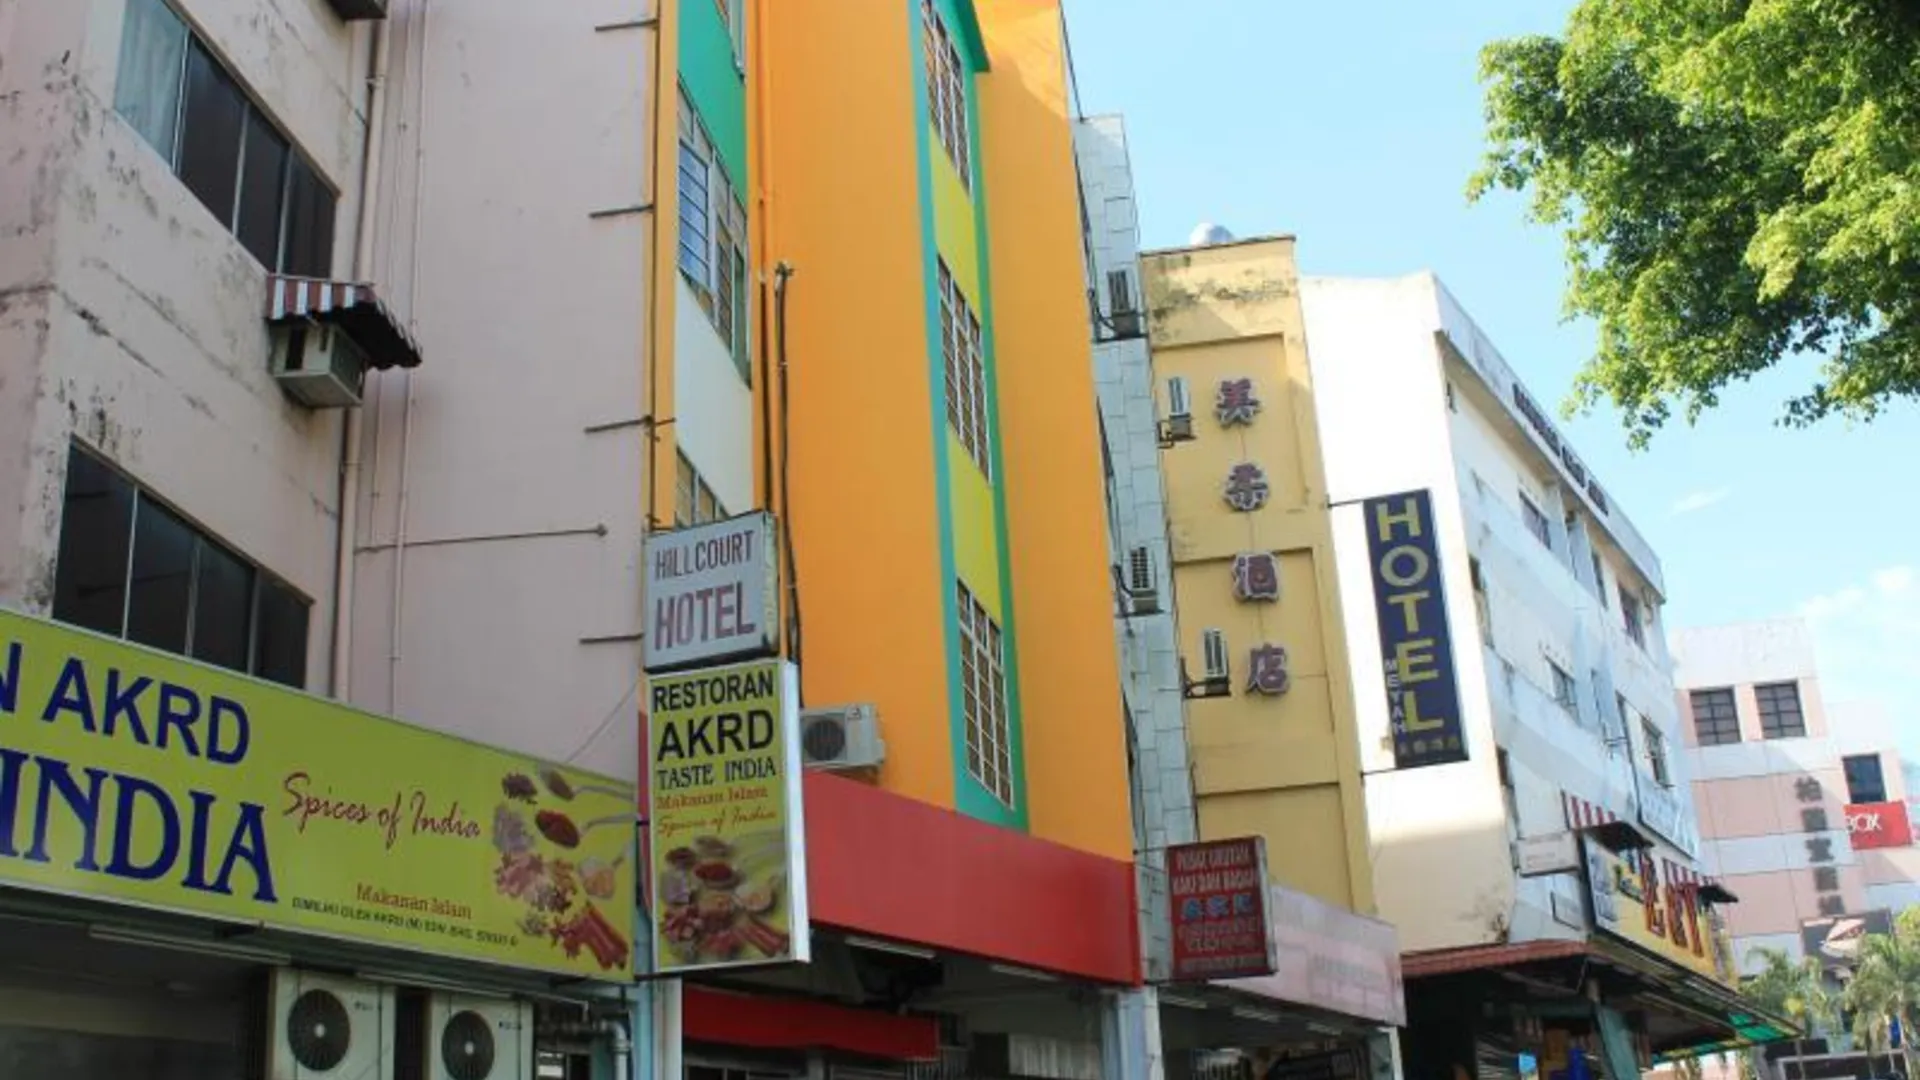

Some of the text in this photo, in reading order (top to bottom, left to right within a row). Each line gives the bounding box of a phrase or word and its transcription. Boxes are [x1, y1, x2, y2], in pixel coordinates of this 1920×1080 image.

[655, 580, 756, 651] HOTEL
[1376, 498, 1444, 731] HOTEL
[42, 657, 249, 764] AKRD
[653, 670, 773, 712] RESTORAN
[657, 709, 774, 761] AKRD
[656, 756, 776, 790] TASTE INDIA
[0, 748, 278, 903] INDIA
[283, 772, 481, 850] Spices of India
